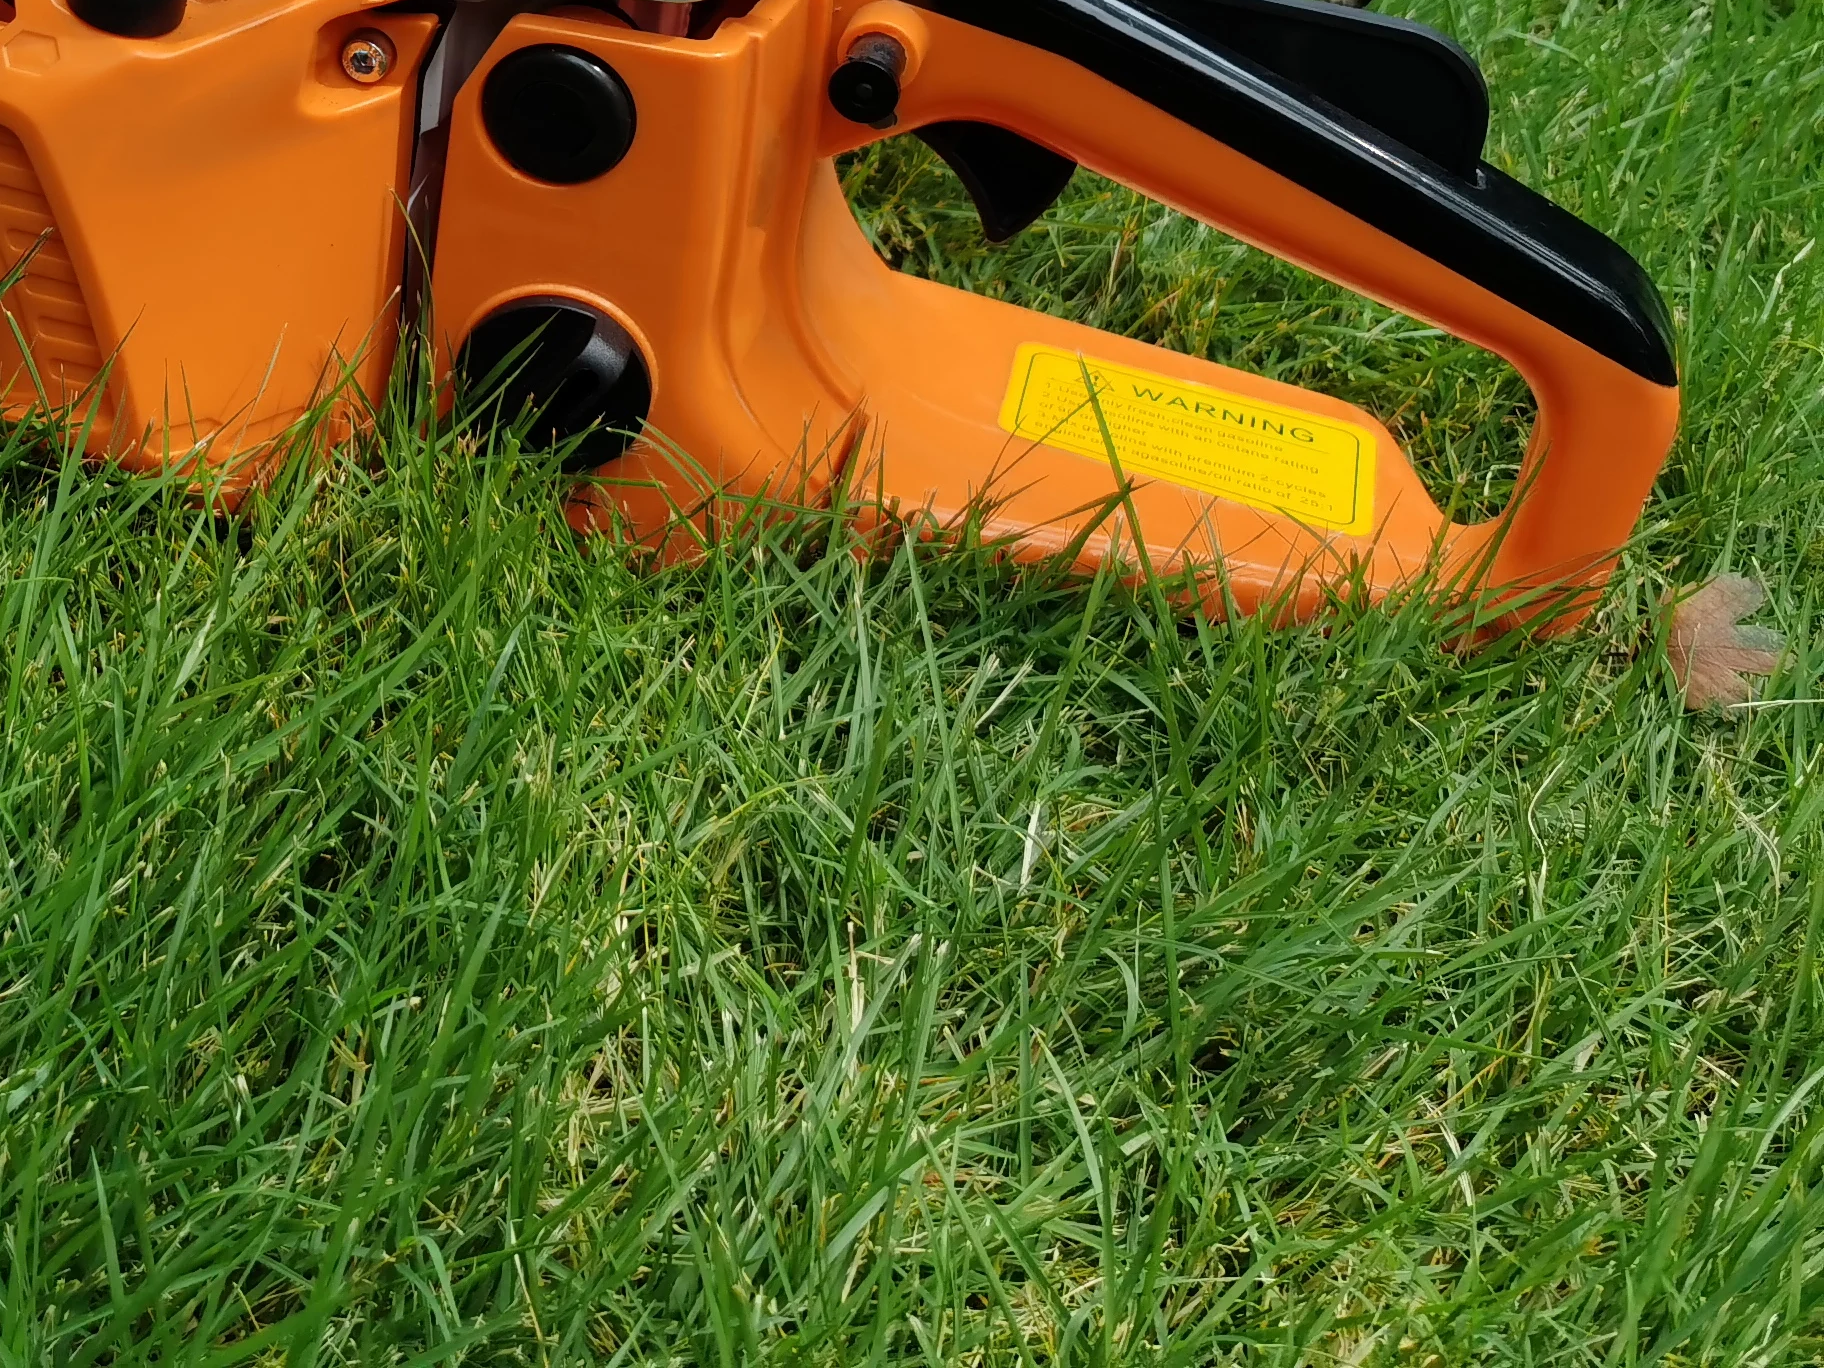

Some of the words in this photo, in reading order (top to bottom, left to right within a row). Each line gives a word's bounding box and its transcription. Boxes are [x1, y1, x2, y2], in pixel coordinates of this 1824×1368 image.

[1094, 395, 1123, 410] nly
[1216, 428, 1283, 454] gasoline
[1097, 416, 1146, 437] igher
[1131, 384, 1315, 443] WARNING
[1150, 442, 1183, 458] with
[1186, 452, 1256, 480] premium
[1157, 422, 1189, 438] with
[1192, 433, 1212, 445] an
[1215, 439, 1269, 461] octane
[1273, 455, 1319, 475] rating
[1235, 477, 1272, 494] ratio
[1275, 488, 1291, 500] of
